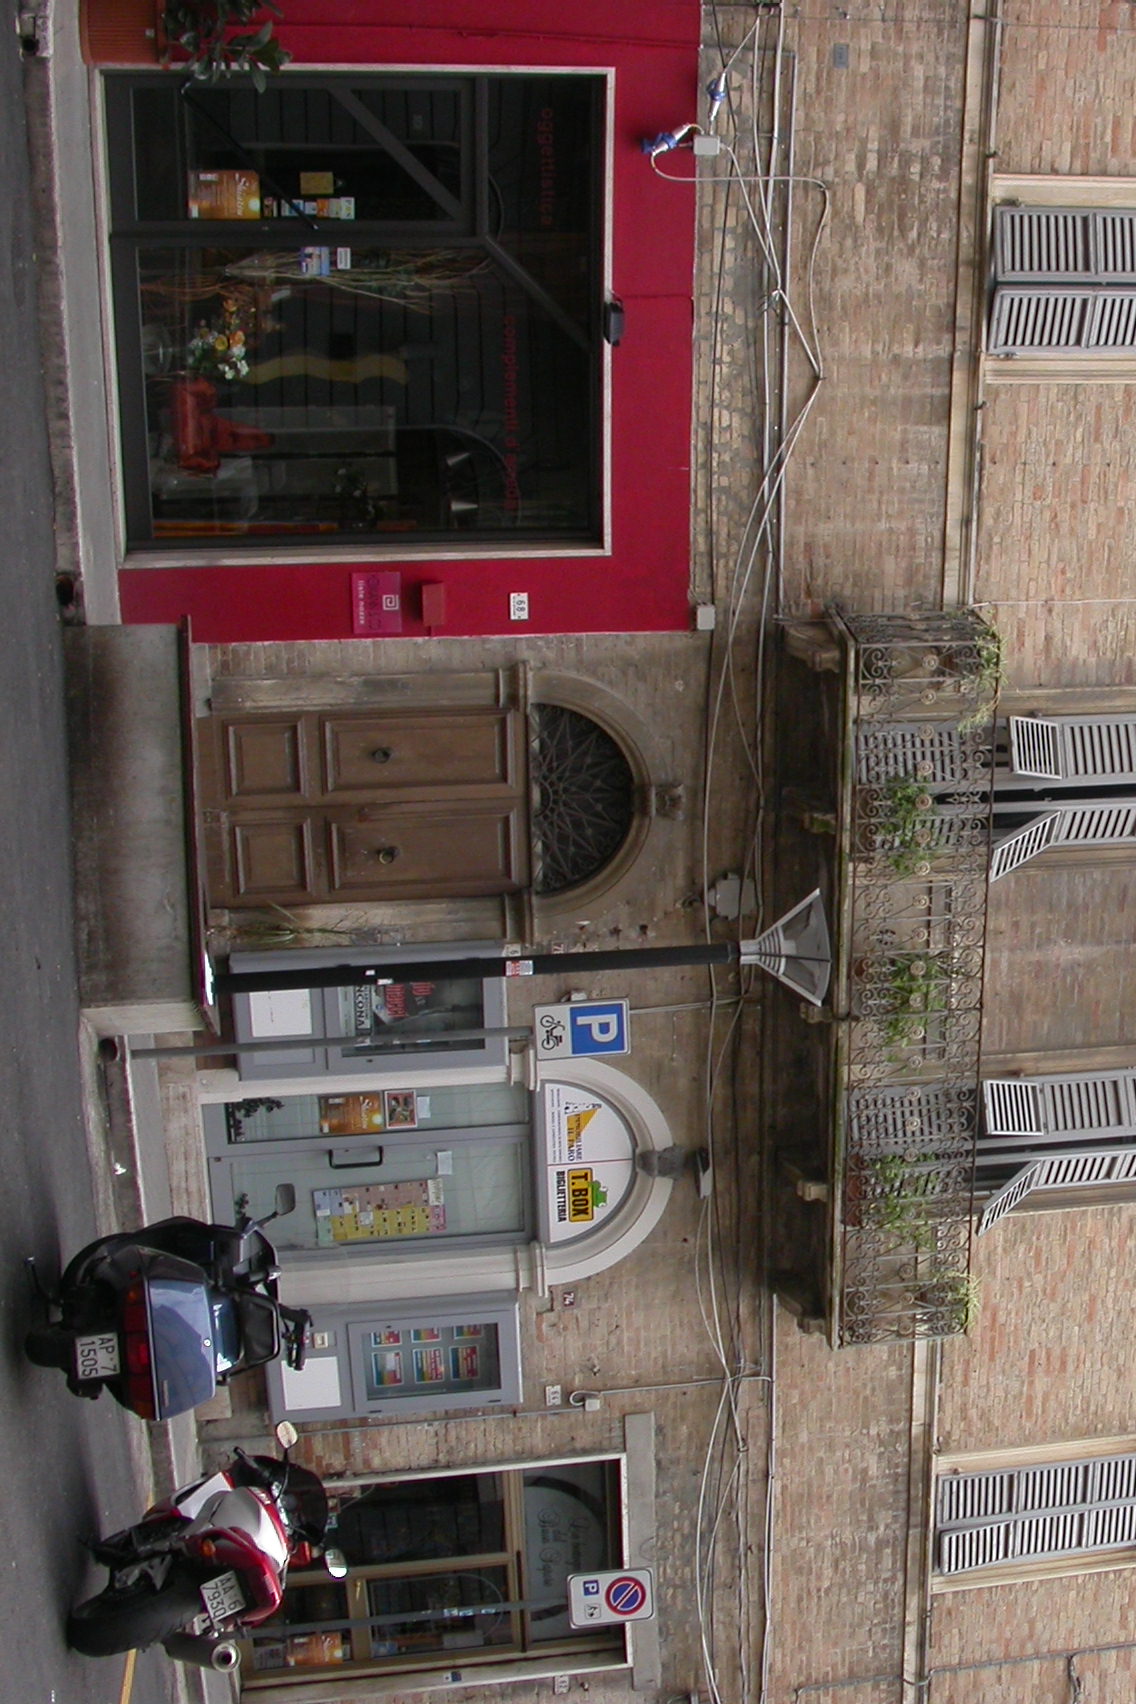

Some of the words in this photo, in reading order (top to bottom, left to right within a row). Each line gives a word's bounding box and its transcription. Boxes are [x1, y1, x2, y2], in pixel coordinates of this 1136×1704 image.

[535, 108, 559, 226] oggettistica
[501, 315, 520, 432] complementi
[516, 600, 526, 612] 68
[576, 1014, 618, 1042] P
[567, 1139, 575, 1162] FARO
[556, 1171, 567, 1223] BIGLIETTERIA
[571, 1188, 589, 1217] BOX
[80, 1340, 98, 1378] 1505
[99, 1338, 115, 1354] AP
[101, 1364, 117, 1373] 7
[202, 1582, 226, 1618] 7930
[585, 1582, 598, 1593] P
